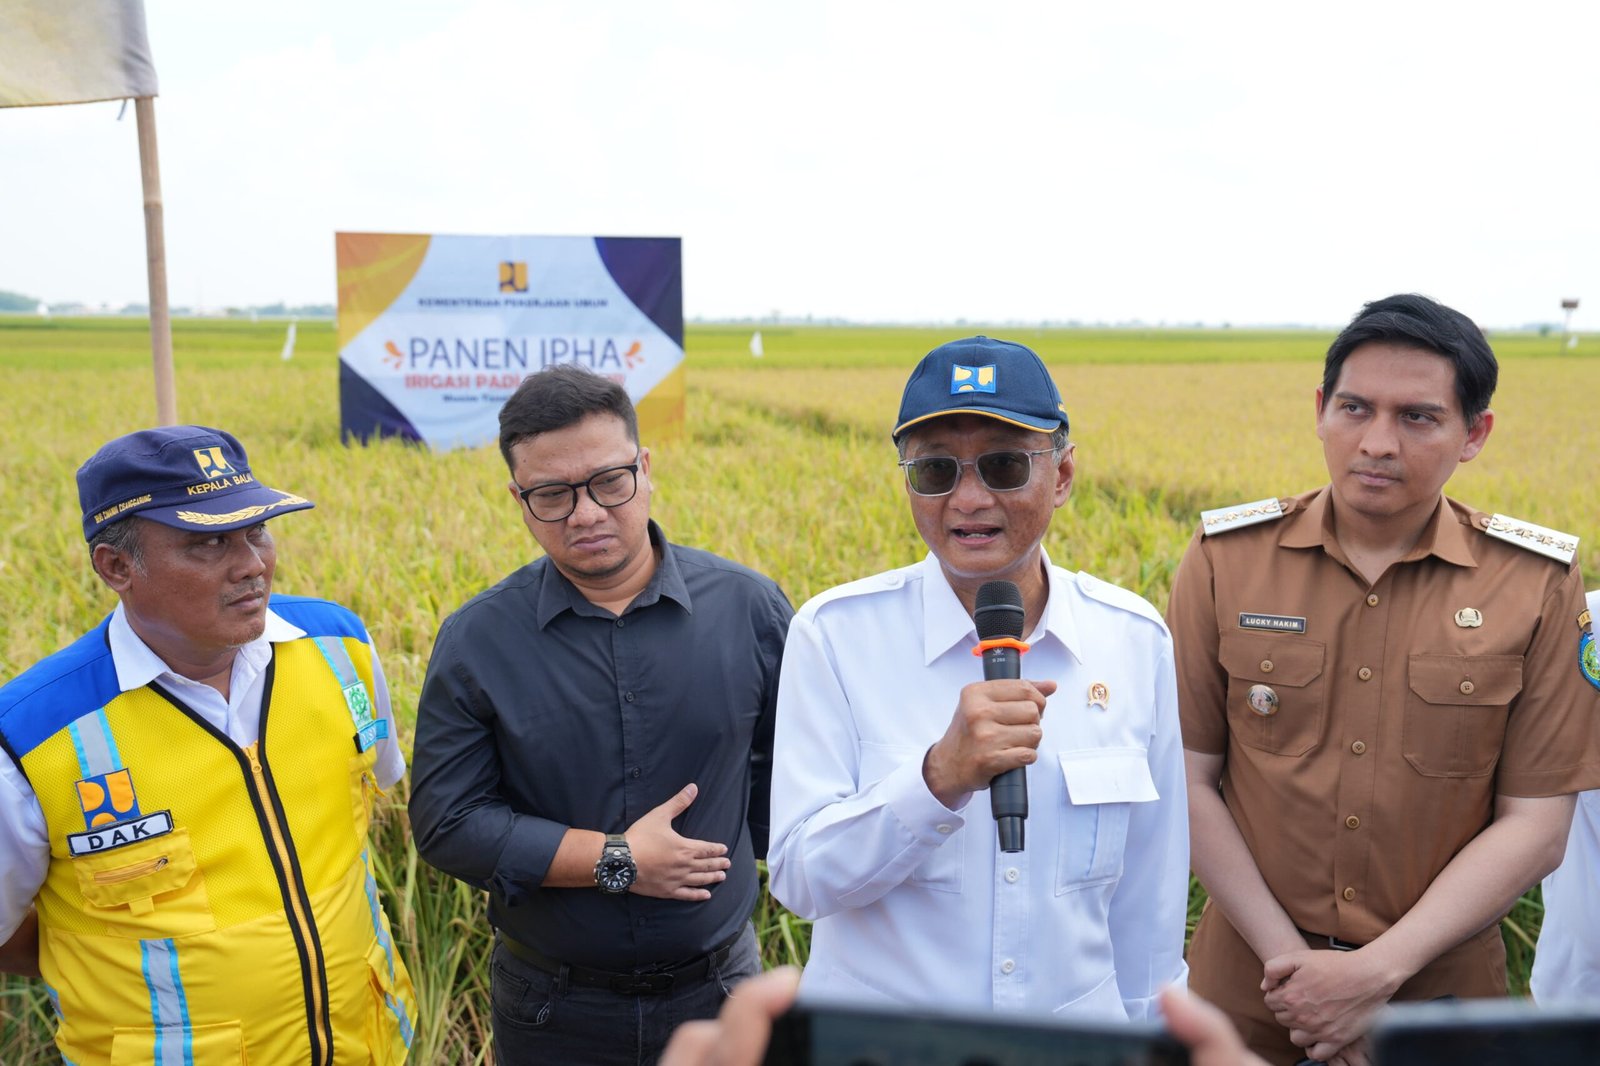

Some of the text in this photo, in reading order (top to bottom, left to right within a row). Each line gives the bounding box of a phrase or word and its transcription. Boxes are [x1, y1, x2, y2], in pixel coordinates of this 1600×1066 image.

[409, 337, 622, 368] PANEN IPHA
[404, 373, 521, 389] IRIGASI PADI
[187, 478, 233, 496] KEPALA
[1246, 617, 1298, 628] LUCKY HAKIM
[87, 821, 151, 850] DAK
